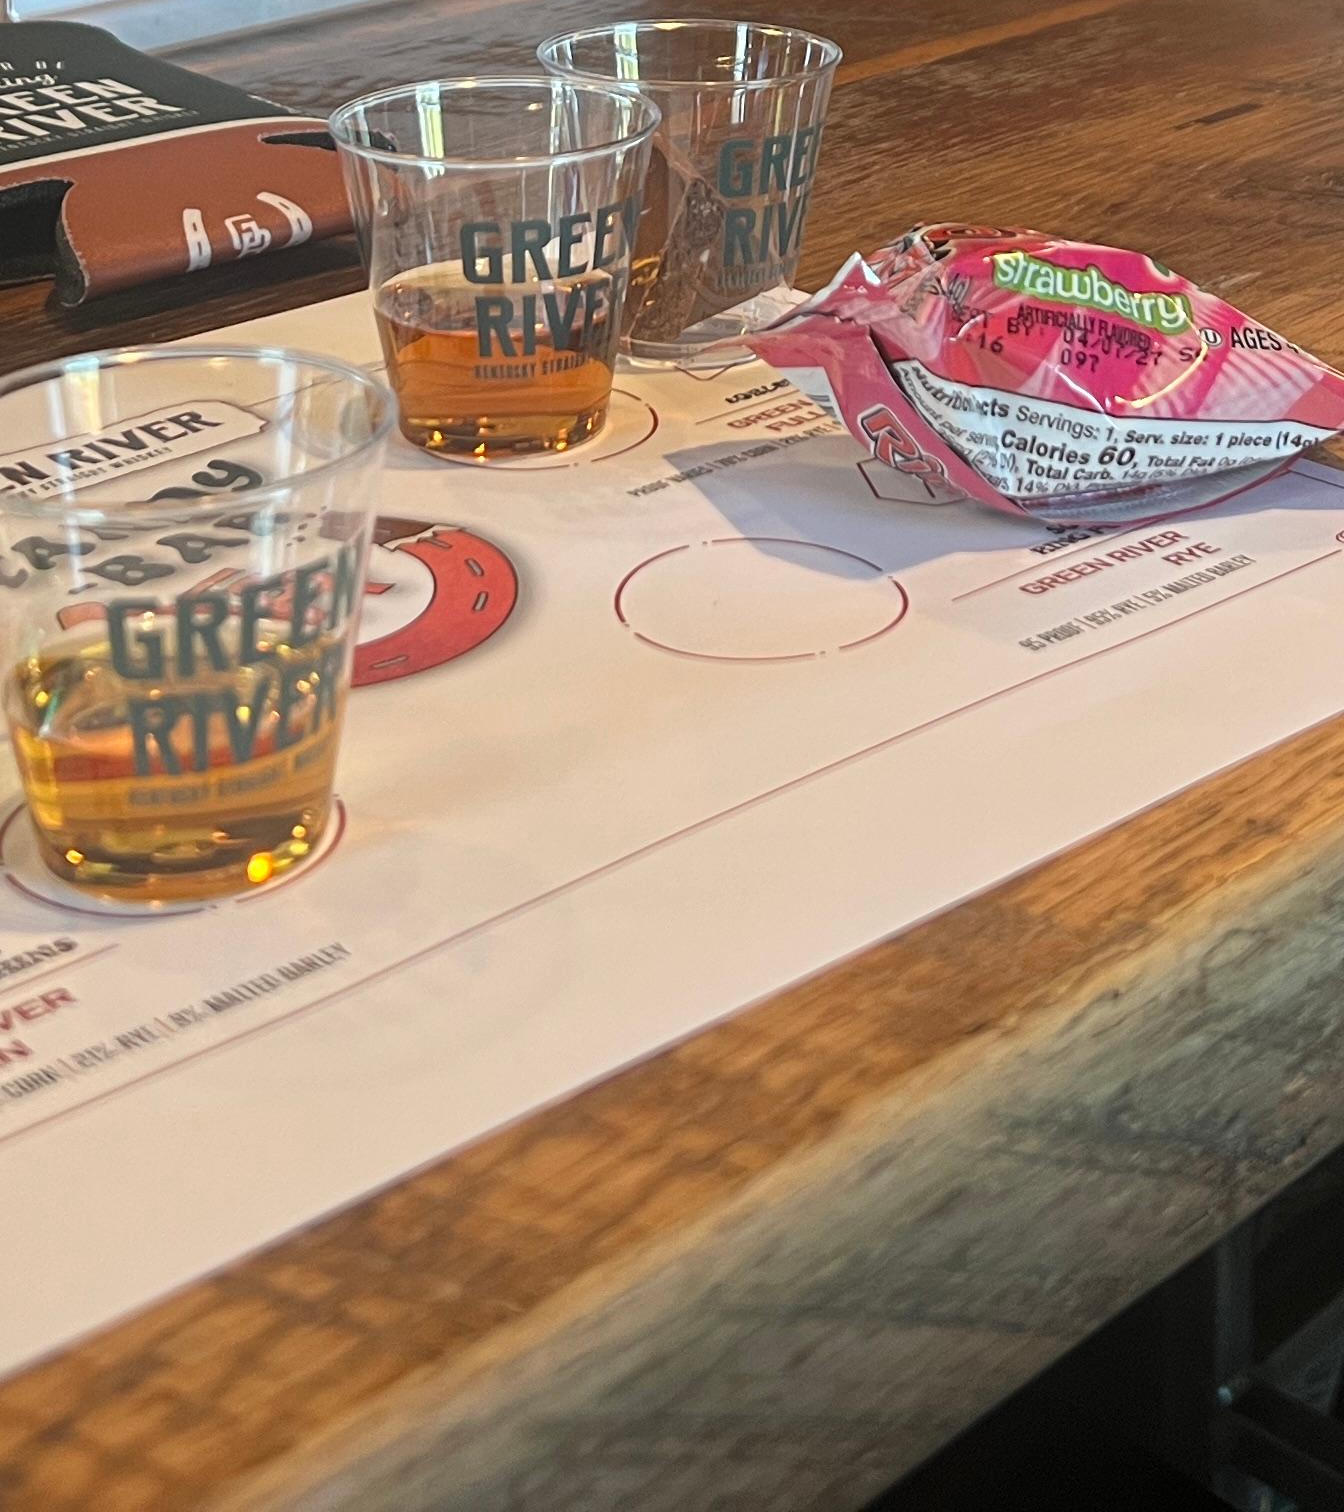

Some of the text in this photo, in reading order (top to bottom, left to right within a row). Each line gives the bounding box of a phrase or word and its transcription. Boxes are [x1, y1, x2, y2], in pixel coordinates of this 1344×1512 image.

[996, 253, 1187, 327] strawberry
[1230, 326, 1283, 352] AGES
[727, 399, 813, 428] GREEN
[766, 410, 829, 432] FULL
[1016, 404, 1100, 440] Servings:
[1125, 431, 1165, 447] Serv.
[1170, 431, 1209, 447] size:
[1215, 431, 1223, 446] 1
[1228, 432, 1272, 449] piece
[46, 410, 224, 471] RIVER
[1001, 429, 1090, 467] Calories
[1097, 445, 1139, 469] 60,
[1026, 460, 1115, 481] Total Carb.
[1018, 530, 1190, 595] GREEN RIVER
[1161, 541, 1222, 567] RYE
